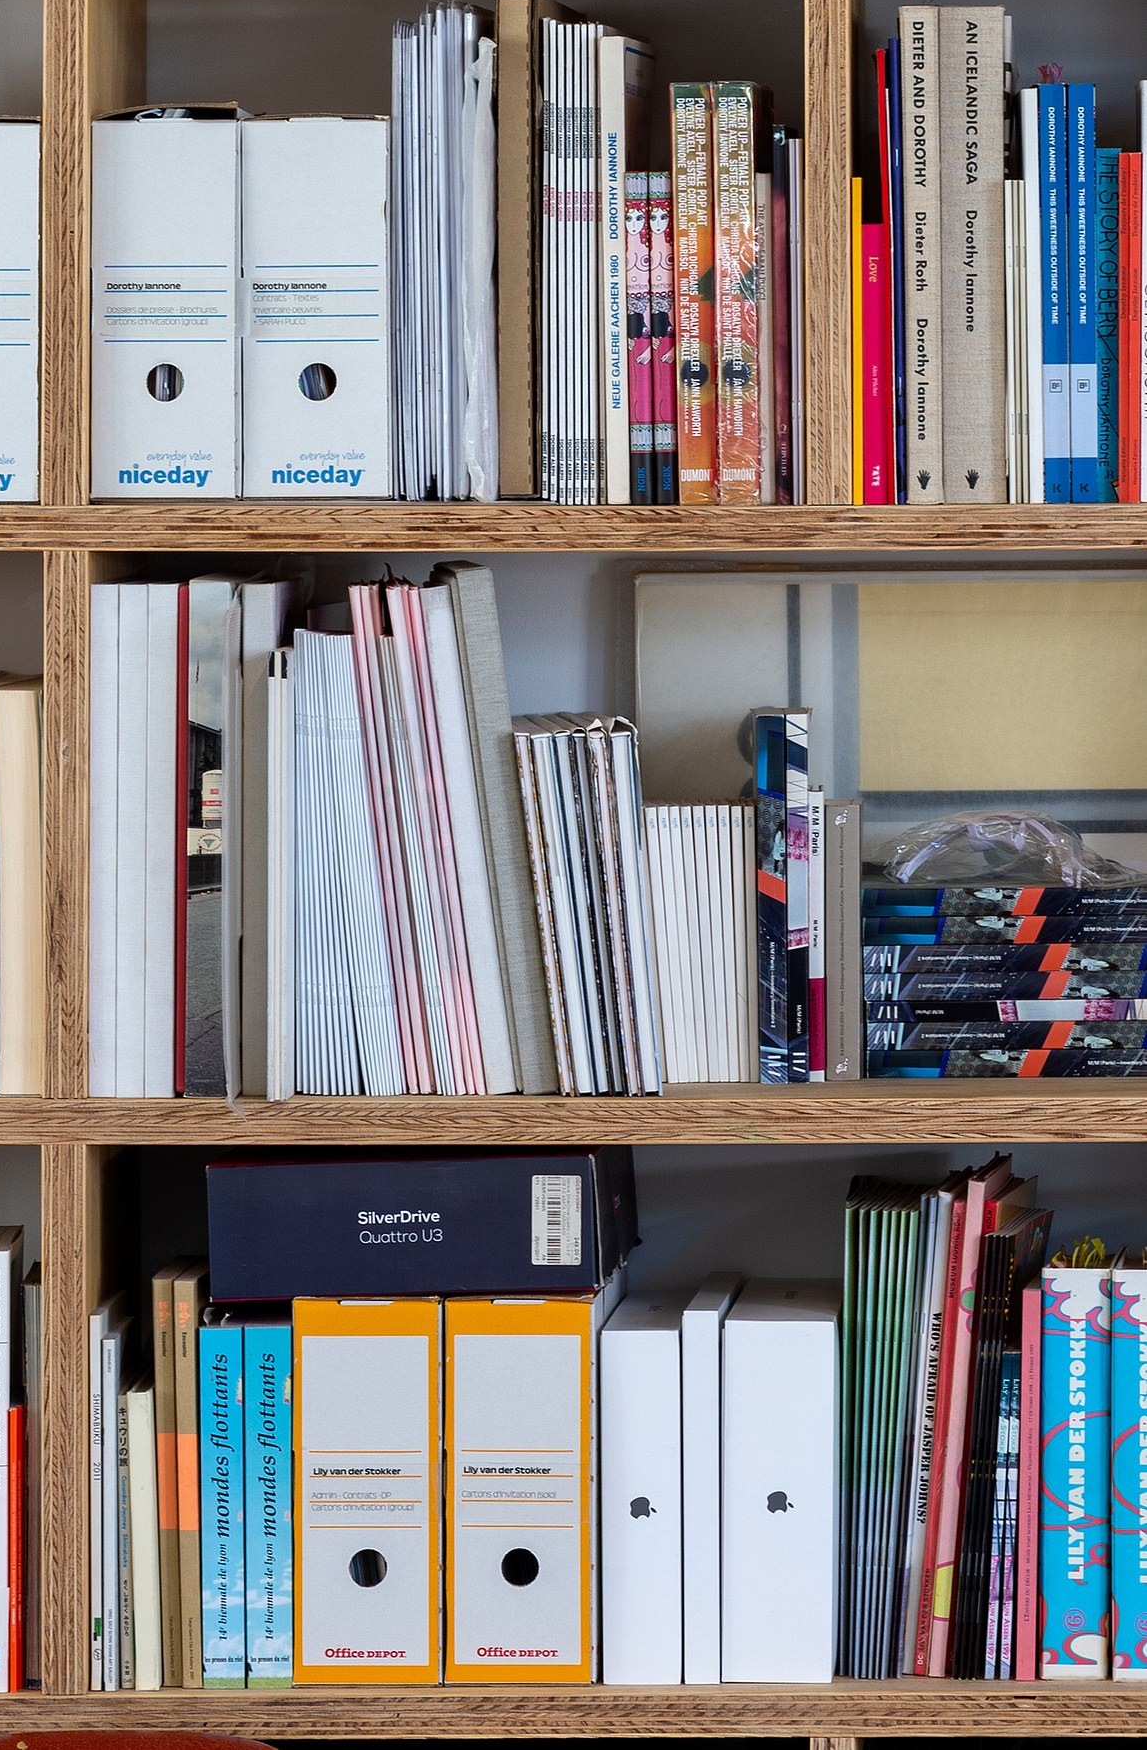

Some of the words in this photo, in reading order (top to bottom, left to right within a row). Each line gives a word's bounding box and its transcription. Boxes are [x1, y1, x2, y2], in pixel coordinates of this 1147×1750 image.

[912, 21, 924, 71] DIETER
[965, 20, 978, 44] AN
[913, 75, 925, 109] AND
[965, 49, 978, 136] ICELANDIC
[607, 132, 618, 183] IANNONE
[913, 115, 927, 188] DOROTHY
[965, 141, 978, 185] SAGA
[608, 185, 618, 240] DOROTHY
[915, 211, 927, 256] Dieter
[963, 209, 978, 268] Dorothy
[106, 282, 143, 290] Dorothy
[144, 282, 181, 290] Iannone
[253, 282, 289, 290] Dorothy
[290, 282, 327, 290] Iannone
[610, 254, 619, 276] 1980
[915, 259, 928, 292] Roth
[610, 281, 620, 327] AACHEN
[965, 273, 978, 333] Iannone
[611, 328, 621, 376] GALERIE
[914, 318, 929, 377] Dorothy
[612, 382, 621, 410] NEUE
[917, 382, 929, 441] Iannone
[118, 463, 209, 487] niceday
[272, 463, 362, 487] niceday
[357, 1210, 440, 1225] SilverDrive
[359, 1231, 418, 1244] Quattro
[422, 1229, 443, 1243] U3
[210, 1353, 235, 1452] flottants
[257, 1353, 282, 1452] flottants
[1068, 1411, 1085, 1462] DER
[313, 1468, 328, 1477] Lily
[365, 1467, 401, 1475] Stokker
[463, 1466, 478, 1475] Lily
[498, 1466, 513, 1474] der
[515, 1466, 551, 1474] Stokker
[210, 1456, 230, 1538] mondes
[257, 1455, 277, 1537] mondes
[1068, 1468, 1085, 1521] VAN
[1067, 1526, 1084, 1580] LILY
[325, 1647, 364, 1659] Office
[366, 1650, 406, 1658] DEPOT
[477, 1647, 518, 1658] Office
